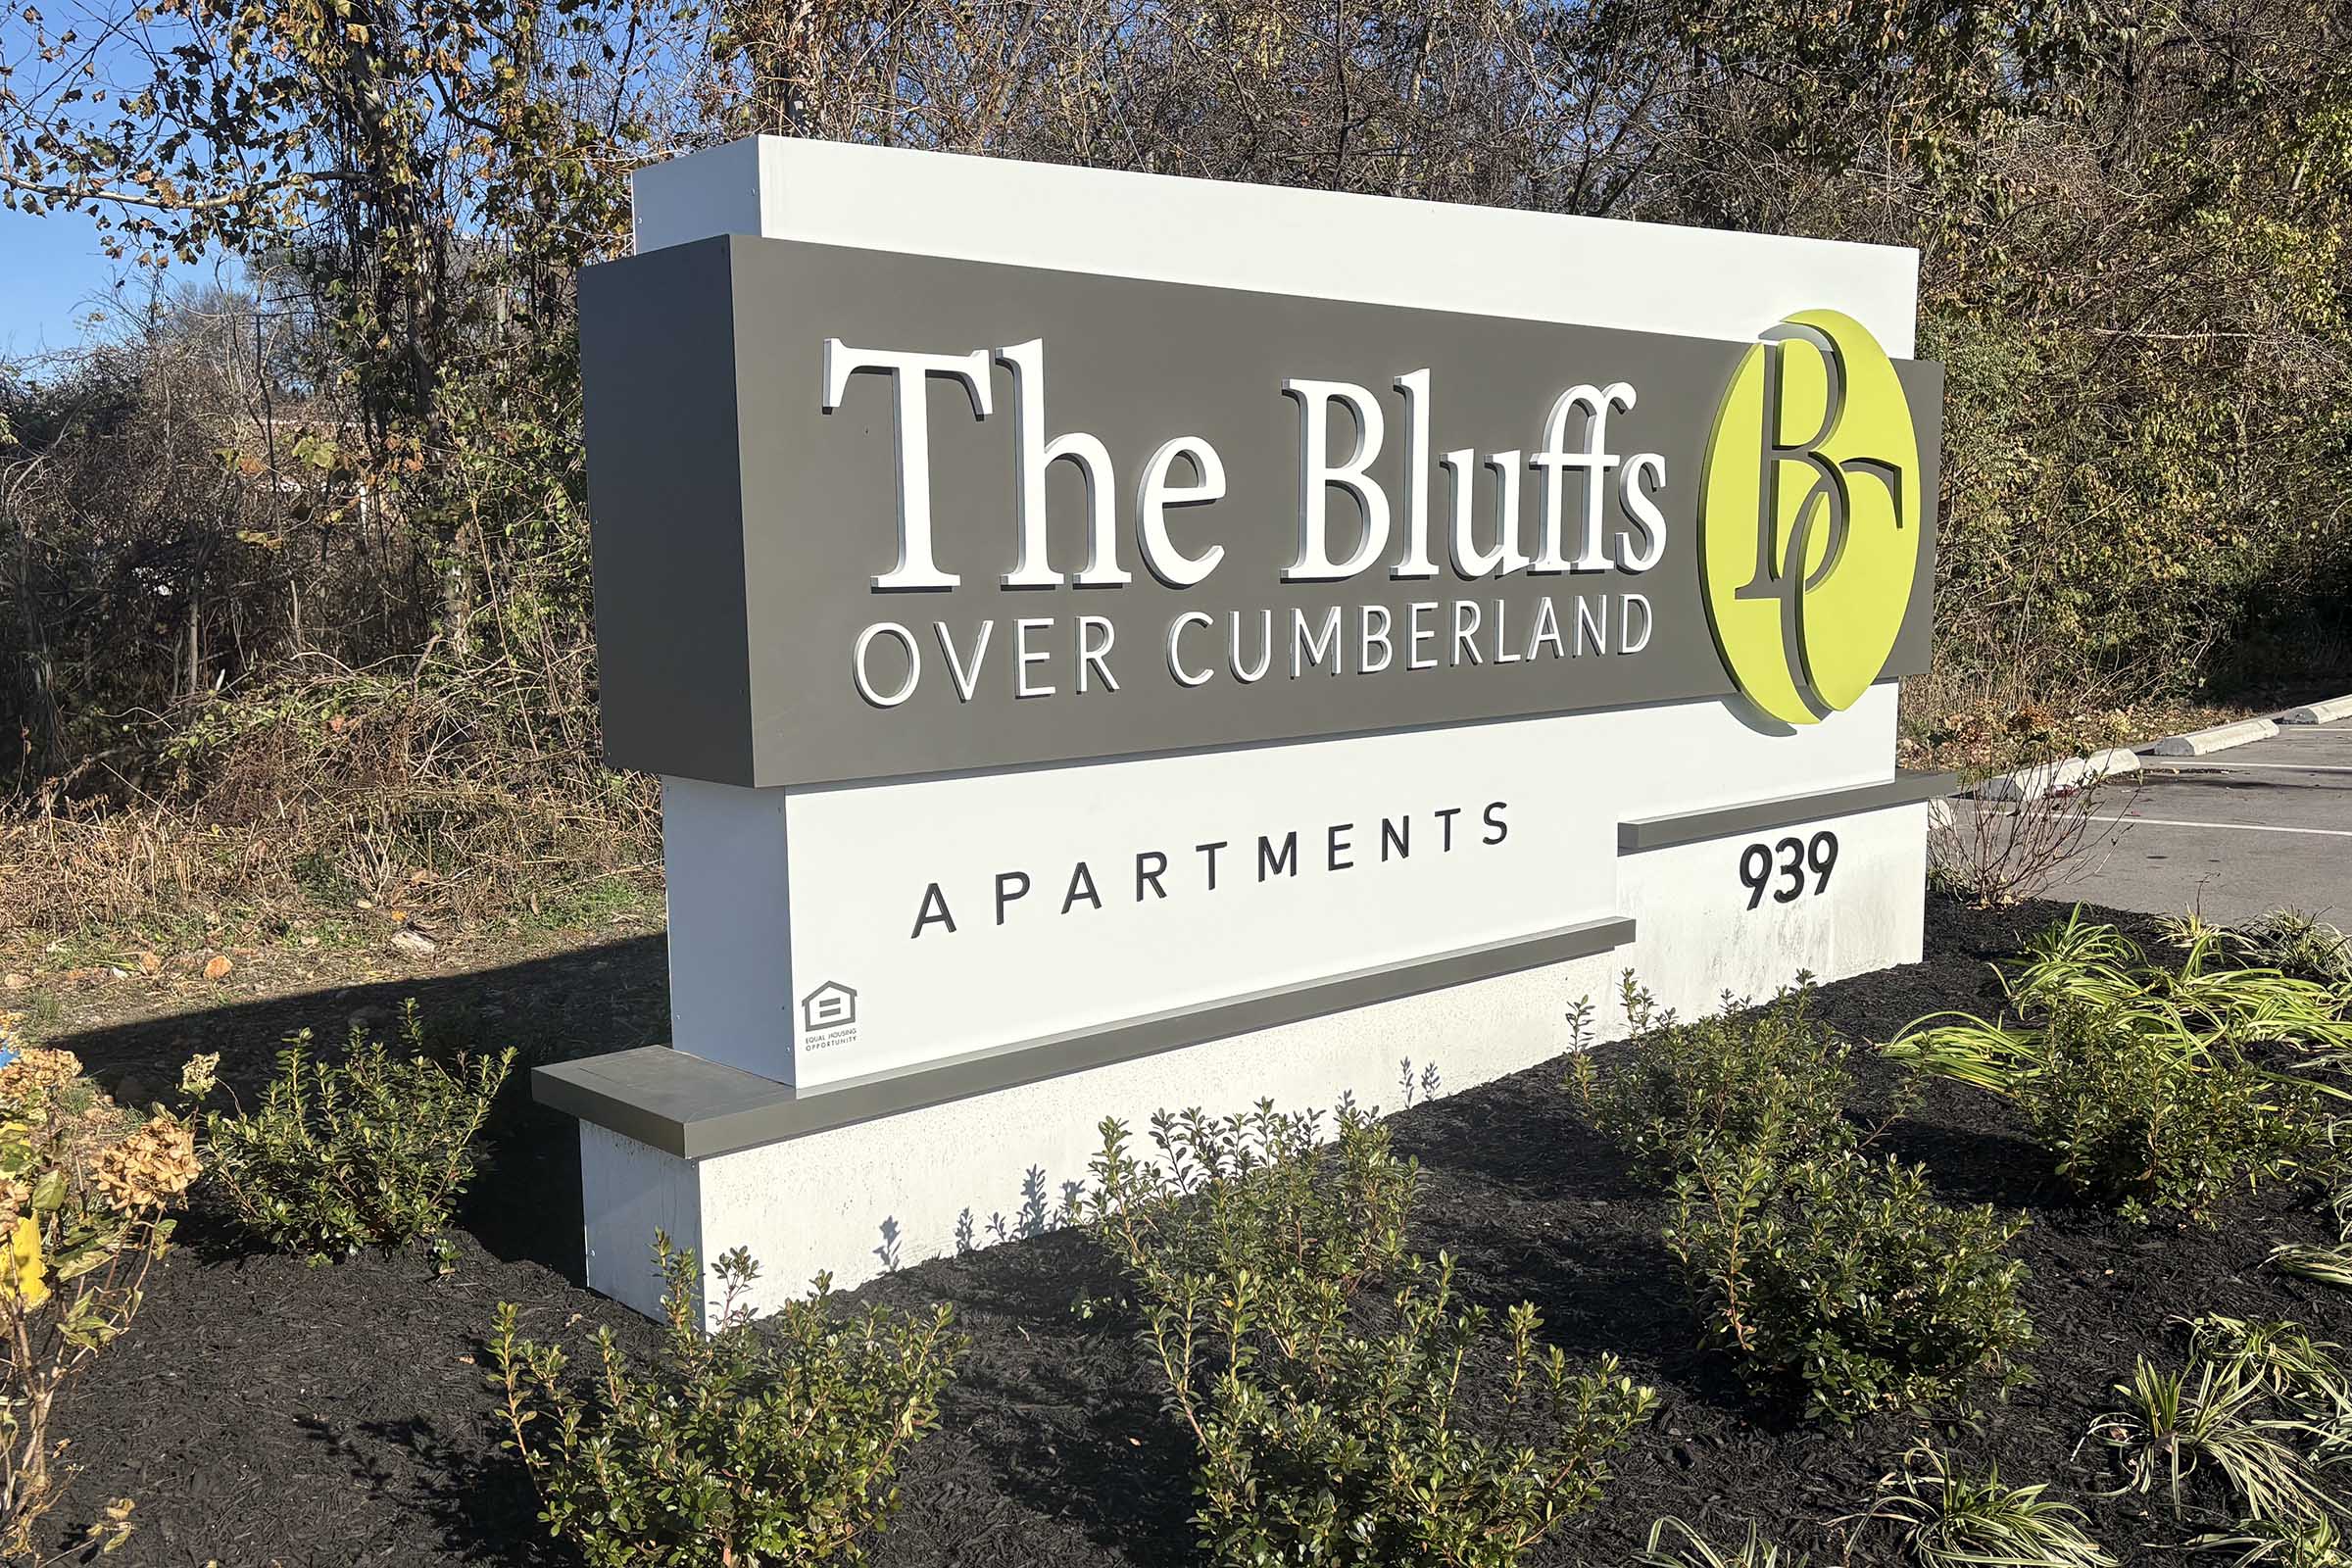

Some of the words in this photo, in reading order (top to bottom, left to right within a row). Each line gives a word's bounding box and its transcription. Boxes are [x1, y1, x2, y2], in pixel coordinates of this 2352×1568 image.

[823, 337, 1226, 591] The
[1281, 368, 1667, 583] Bluffs
[853, 617, 1120, 709] OVER
[1166, 594, 1653, 687] CUMBERLAND
[911, 802, 1509, 939] APARTMENTS
[1740, 830, 1838, 911] 939
